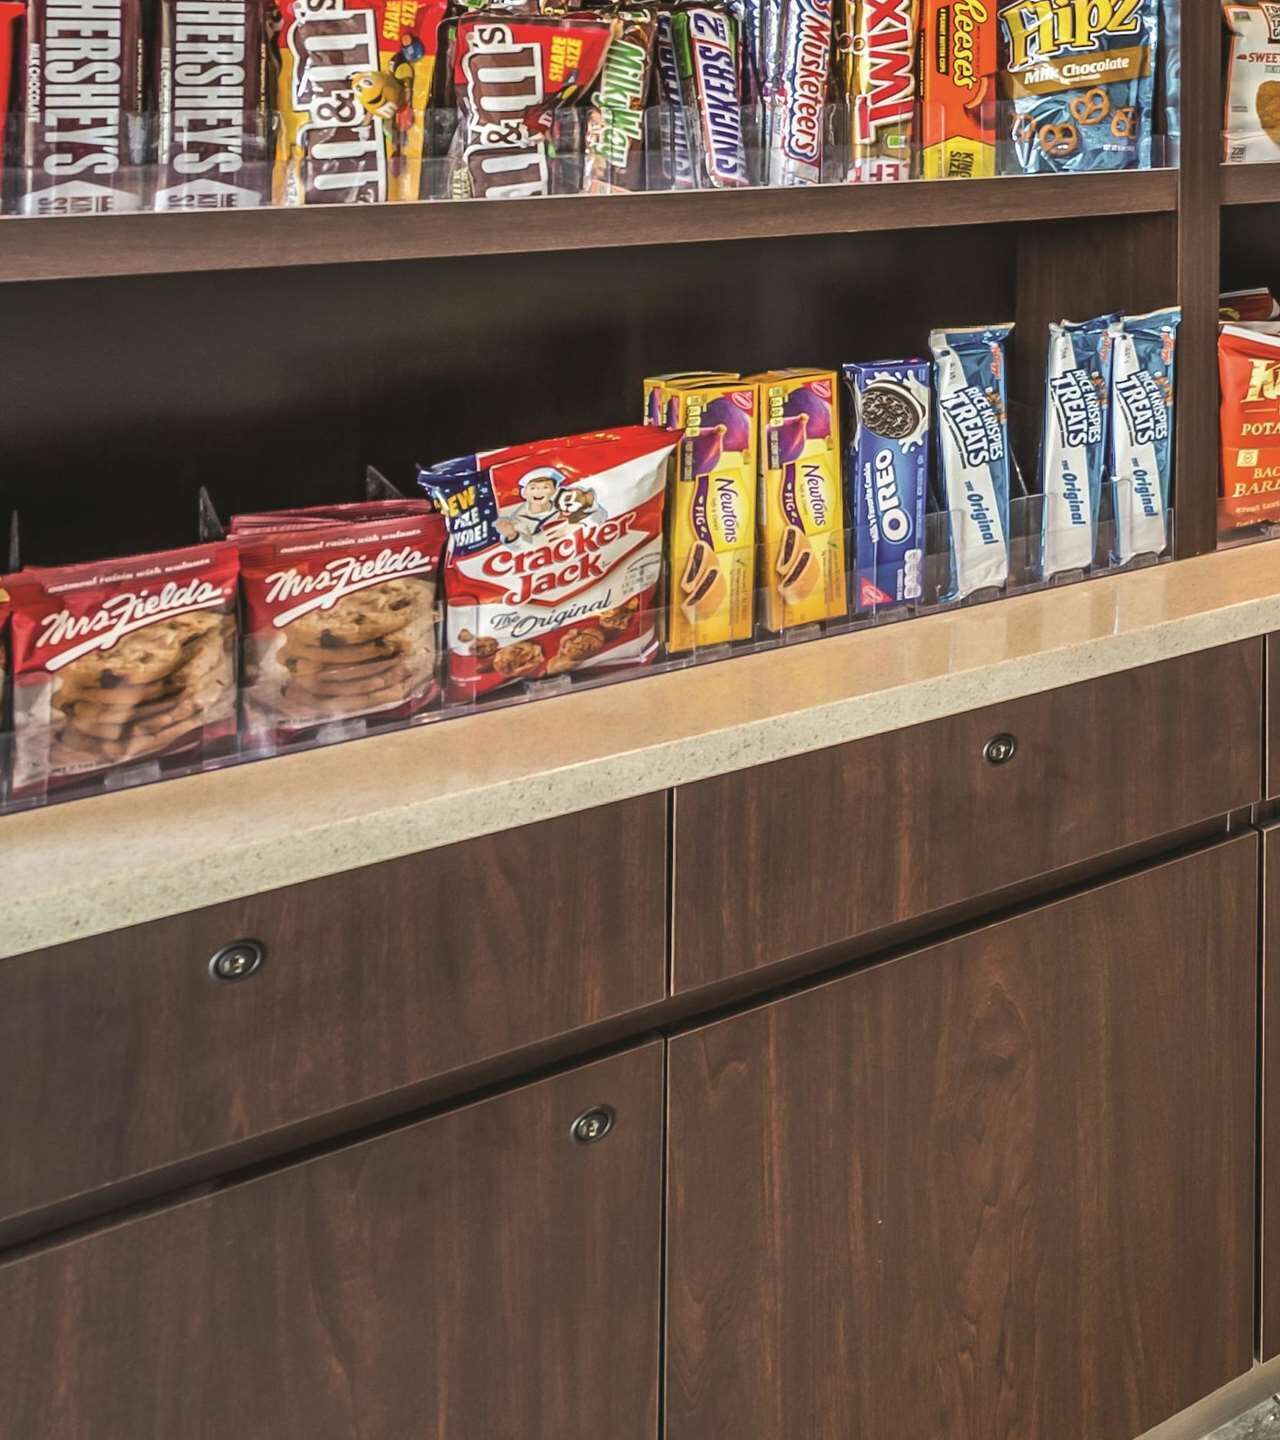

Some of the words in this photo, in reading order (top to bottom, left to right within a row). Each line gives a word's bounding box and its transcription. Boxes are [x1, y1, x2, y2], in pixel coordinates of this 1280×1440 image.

[382, 1, 402, 41] SHARE
[400, 0, 419, 28] SIZE
[549, 36, 567, 82] SHARE
[565, 38, 583, 68] SIZE
[1062, 56, 1130, 77] Chocolate
[172, 1, 246, 174] HERSHEY'S
[704, 46, 740, 178] SNICKERS
[797, 18, 831, 160] Musketeers
[941, 390, 990, 468] TREATS
[1050, 376, 1088, 447] TREATS
[1116, 379, 1154, 446] TREATS
[714, 477, 737, 543] Newtons
[785, 492, 795, 512] FIG
[800, 464, 826, 526] Newtons
[875, 448, 912, 543] OREO
[966, 493, 999, 545] Original
[1060, 473, 1086, 525] Original
[1132, 469, 1158, 517] Original
[481, 511, 635, 576] Cracker
[505, 553, 603, 606] Jack
[490, 612, 518, 628] The
[510, 589, 612, 637] Original
